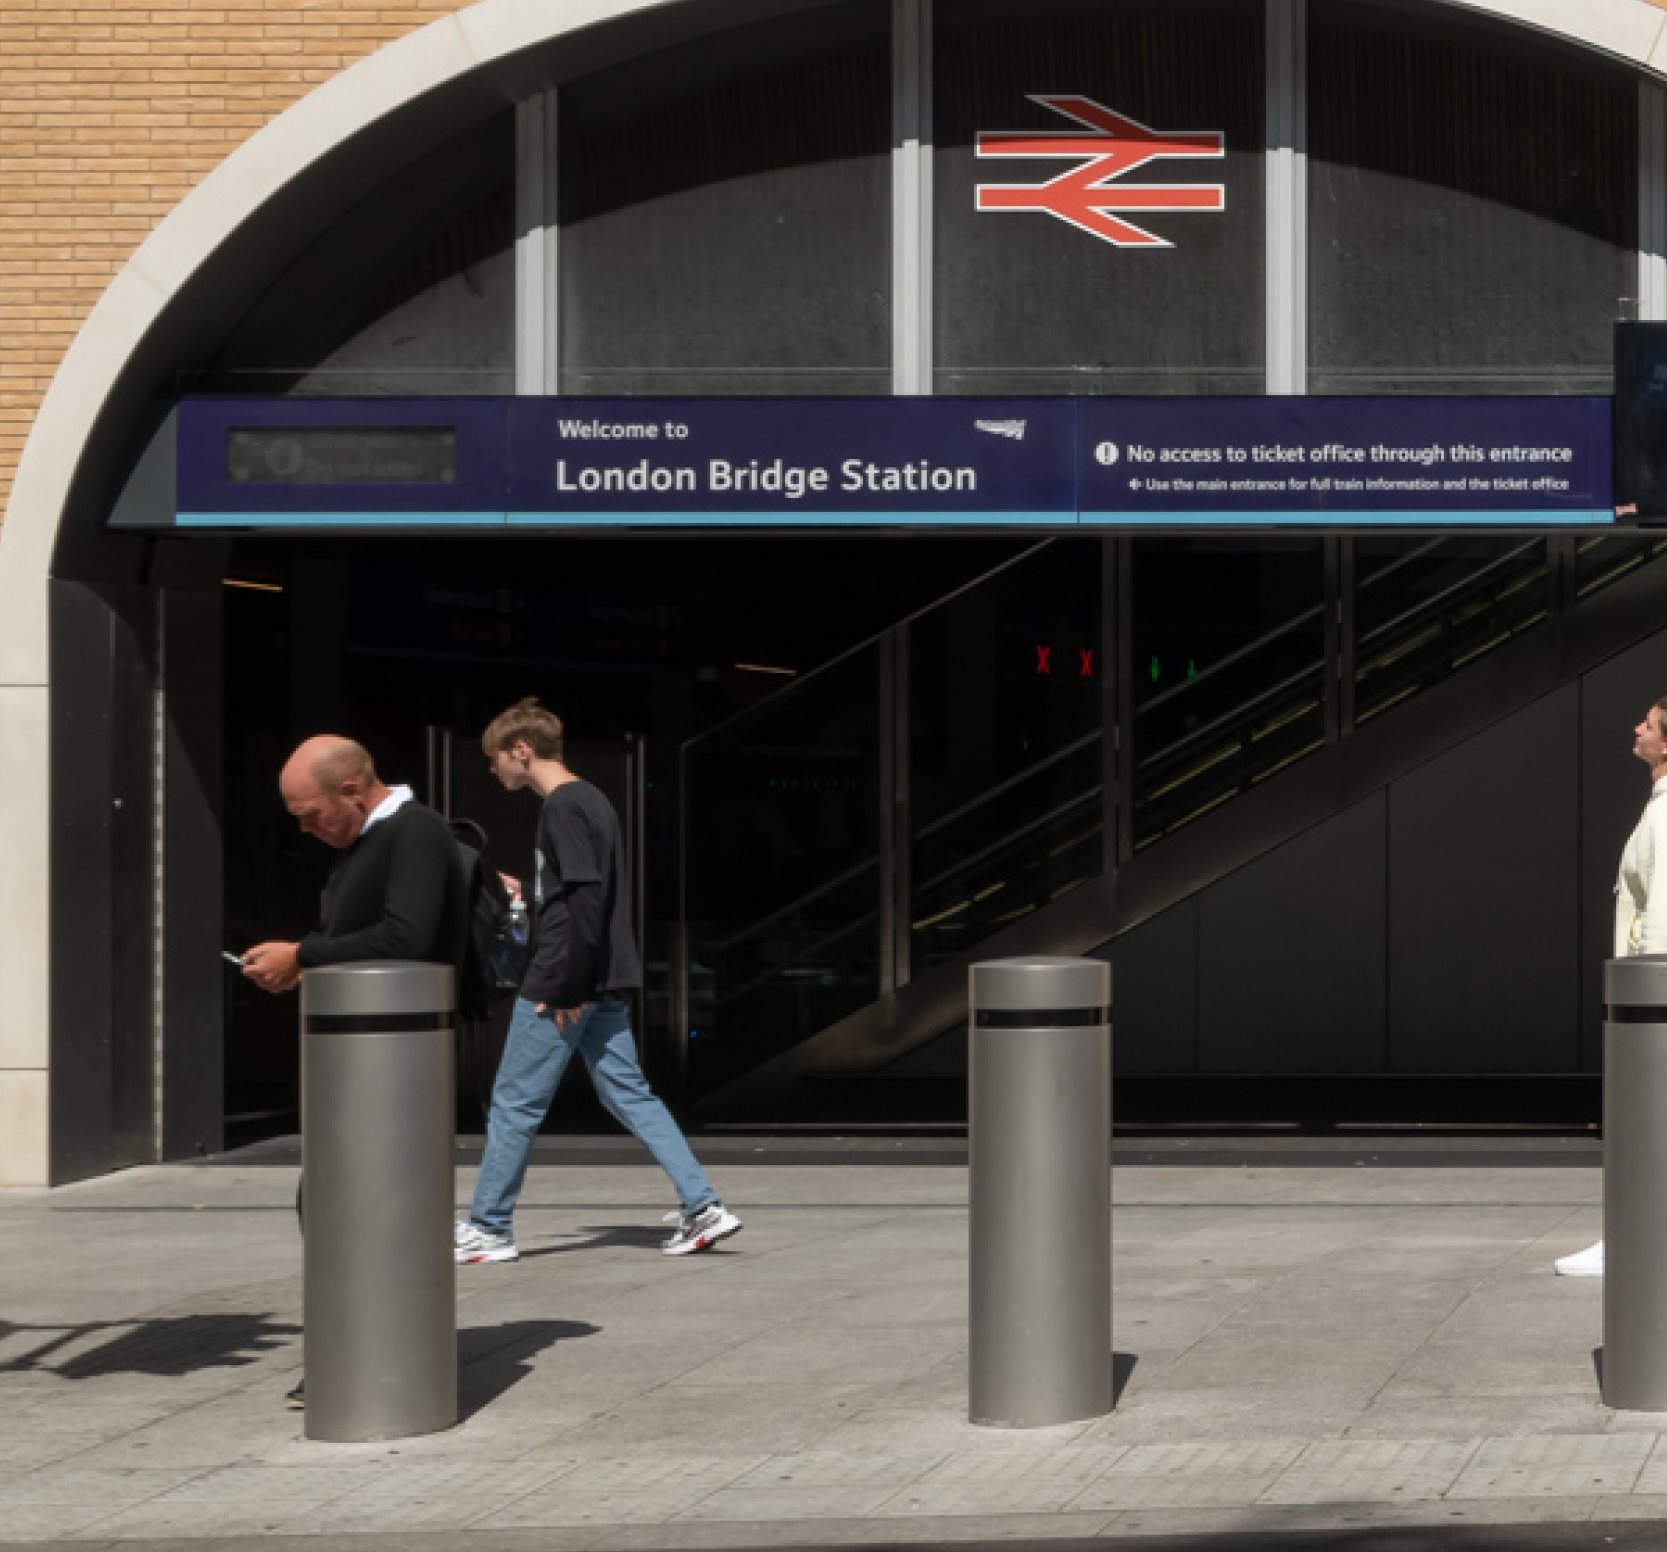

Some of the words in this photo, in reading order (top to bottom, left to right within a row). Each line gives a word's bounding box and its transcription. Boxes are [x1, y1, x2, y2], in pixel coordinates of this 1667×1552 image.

[556, 419, 659, 440] Welcome
[664, 421, 689, 440] to
[1126, 444, 1156, 463] No
[1159, 447, 1223, 463] access
[1226, 445, 1248, 463] to
[1251, 444, 1306, 463] ticket
[1309, 444, 1367, 463] office
[1370, 444, 1445, 466] through
[1448, 444, 1486, 463] this
[1488, 444, 1573, 463] entrance
[556, 458, 697, 492] London
[709, 458, 830, 499] Bridge
[840, 458, 977, 492] Station
[1145, 478, 1171, 491] Use
[1172, 478, 1195, 491] the
[1195, 477, 1228, 491] main
[1229, 477, 1287, 491] entrance
[1287, 477, 1309, 491] for
[1309, 477, 1331, 491] full
[1331, 477, 1364, 491] train
[1365, 477, 1441, 491] information
[1442, 477, 1467, 491] and
[1468, 477, 1491, 491] the
[1492, 477, 1530, 491] ticket
[1531, 477, 1570, 491] office
